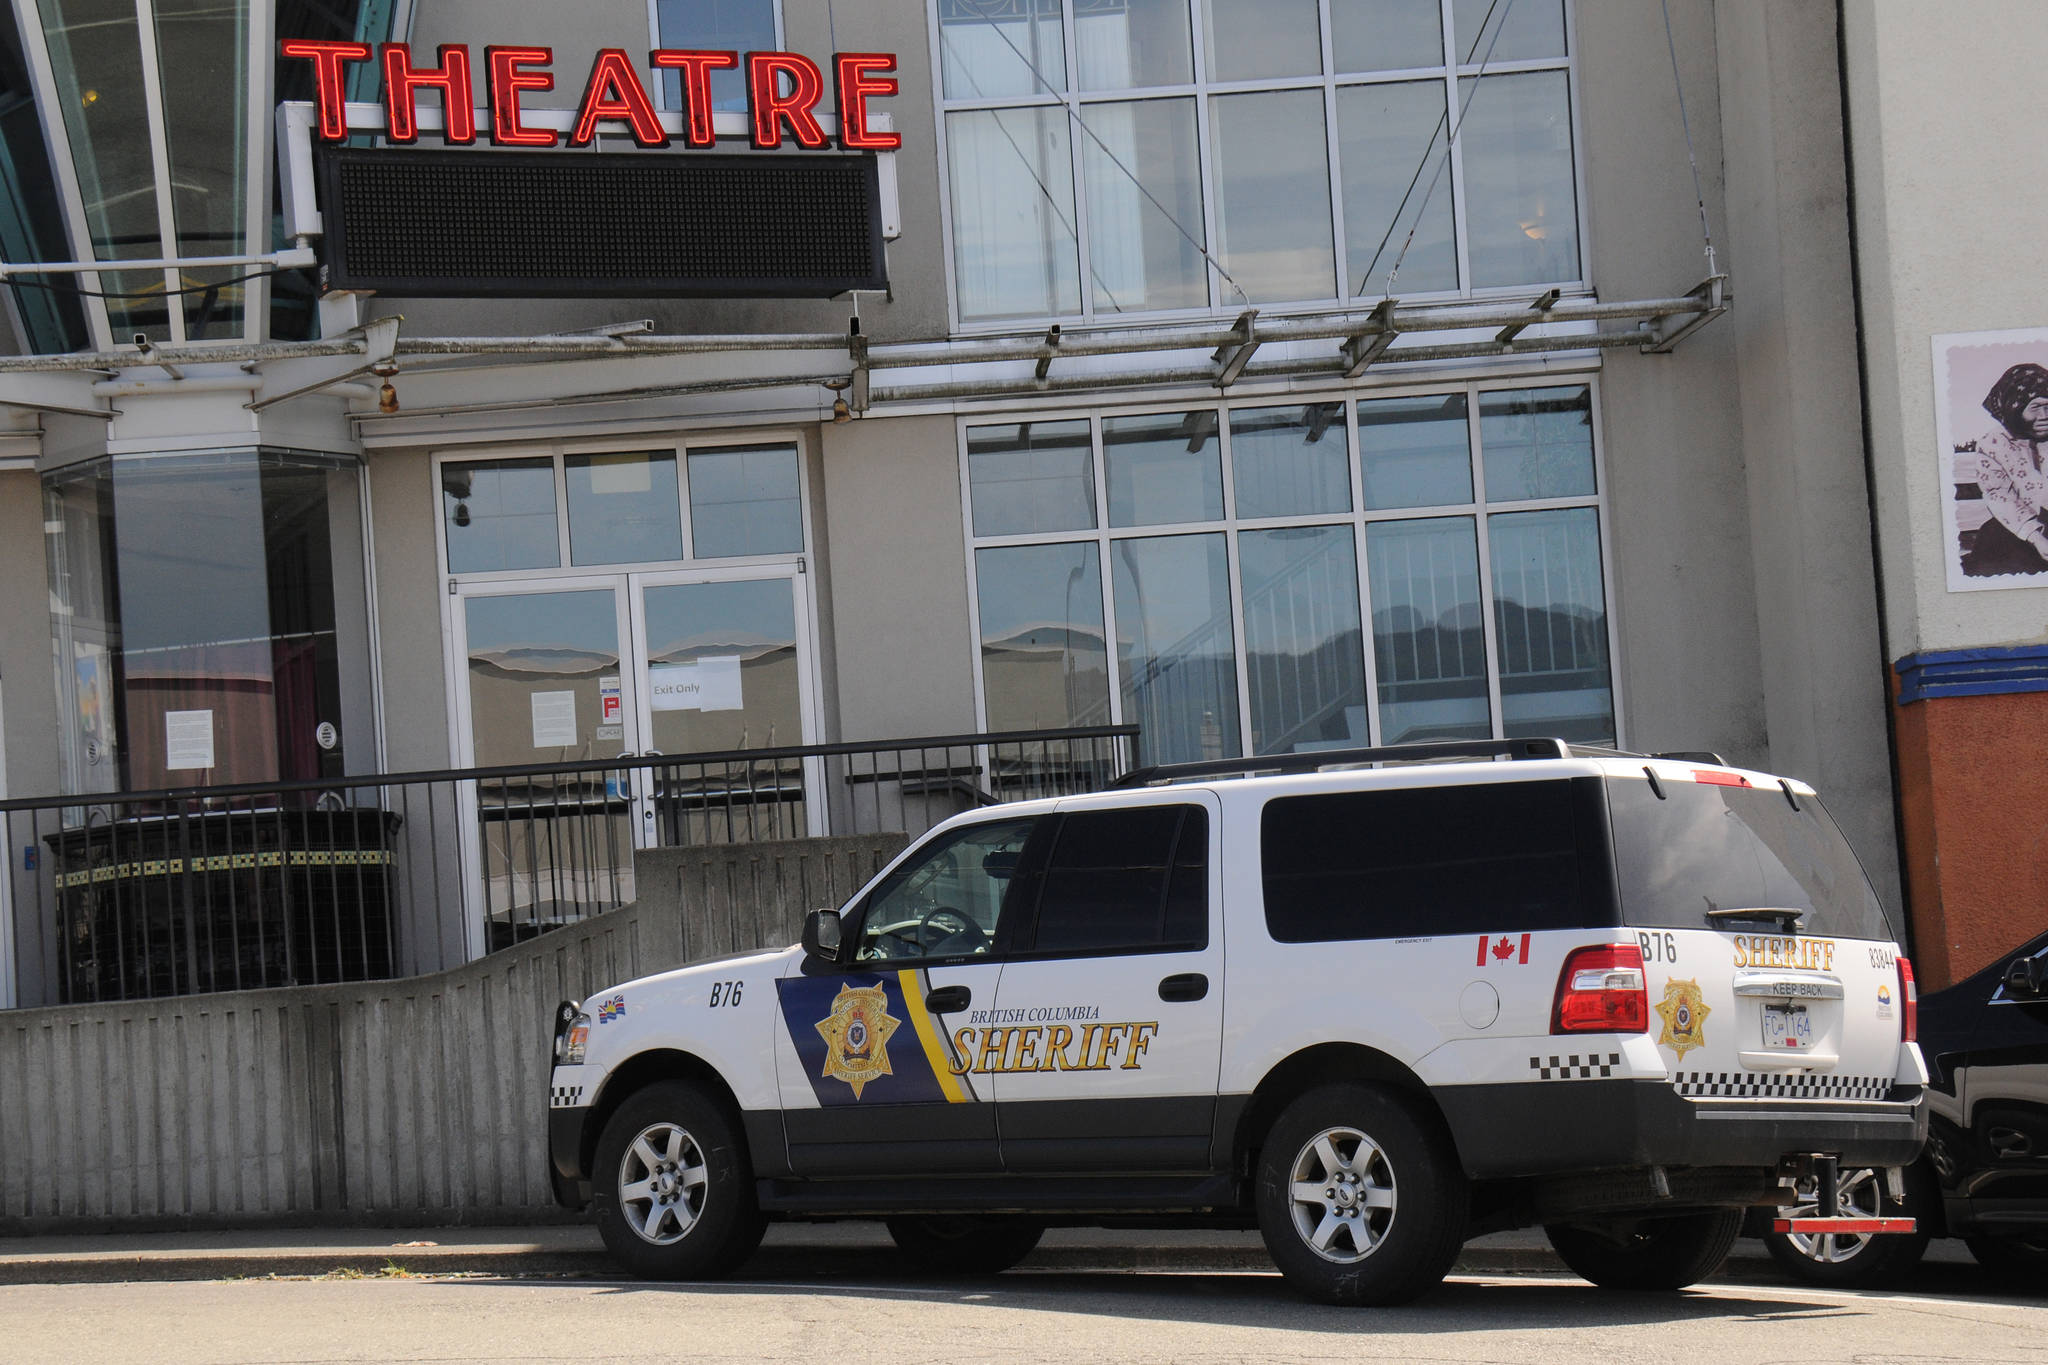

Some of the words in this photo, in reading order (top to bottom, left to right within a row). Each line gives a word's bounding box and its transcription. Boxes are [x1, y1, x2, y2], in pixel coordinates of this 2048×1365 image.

[280, 39, 902, 151] THEATRE
[654, 684, 673, 695] Exit
[676, 683, 700, 694] Only
[1639, 932, 1677, 963] B76
[1733, 935, 1835, 971] SHERIFF
[1869, 948, 1895, 969] 83844
[709, 981, 744, 1008] B76
[1773, 983, 1797, 995] KEEP
[1801, 984, 1823, 996] BACK
[970, 1009, 1025, 1024] BRITISH
[1028, 1006, 1100, 1022] COLUMBIA
[948, 1021, 1159, 1075] SHERIFF
